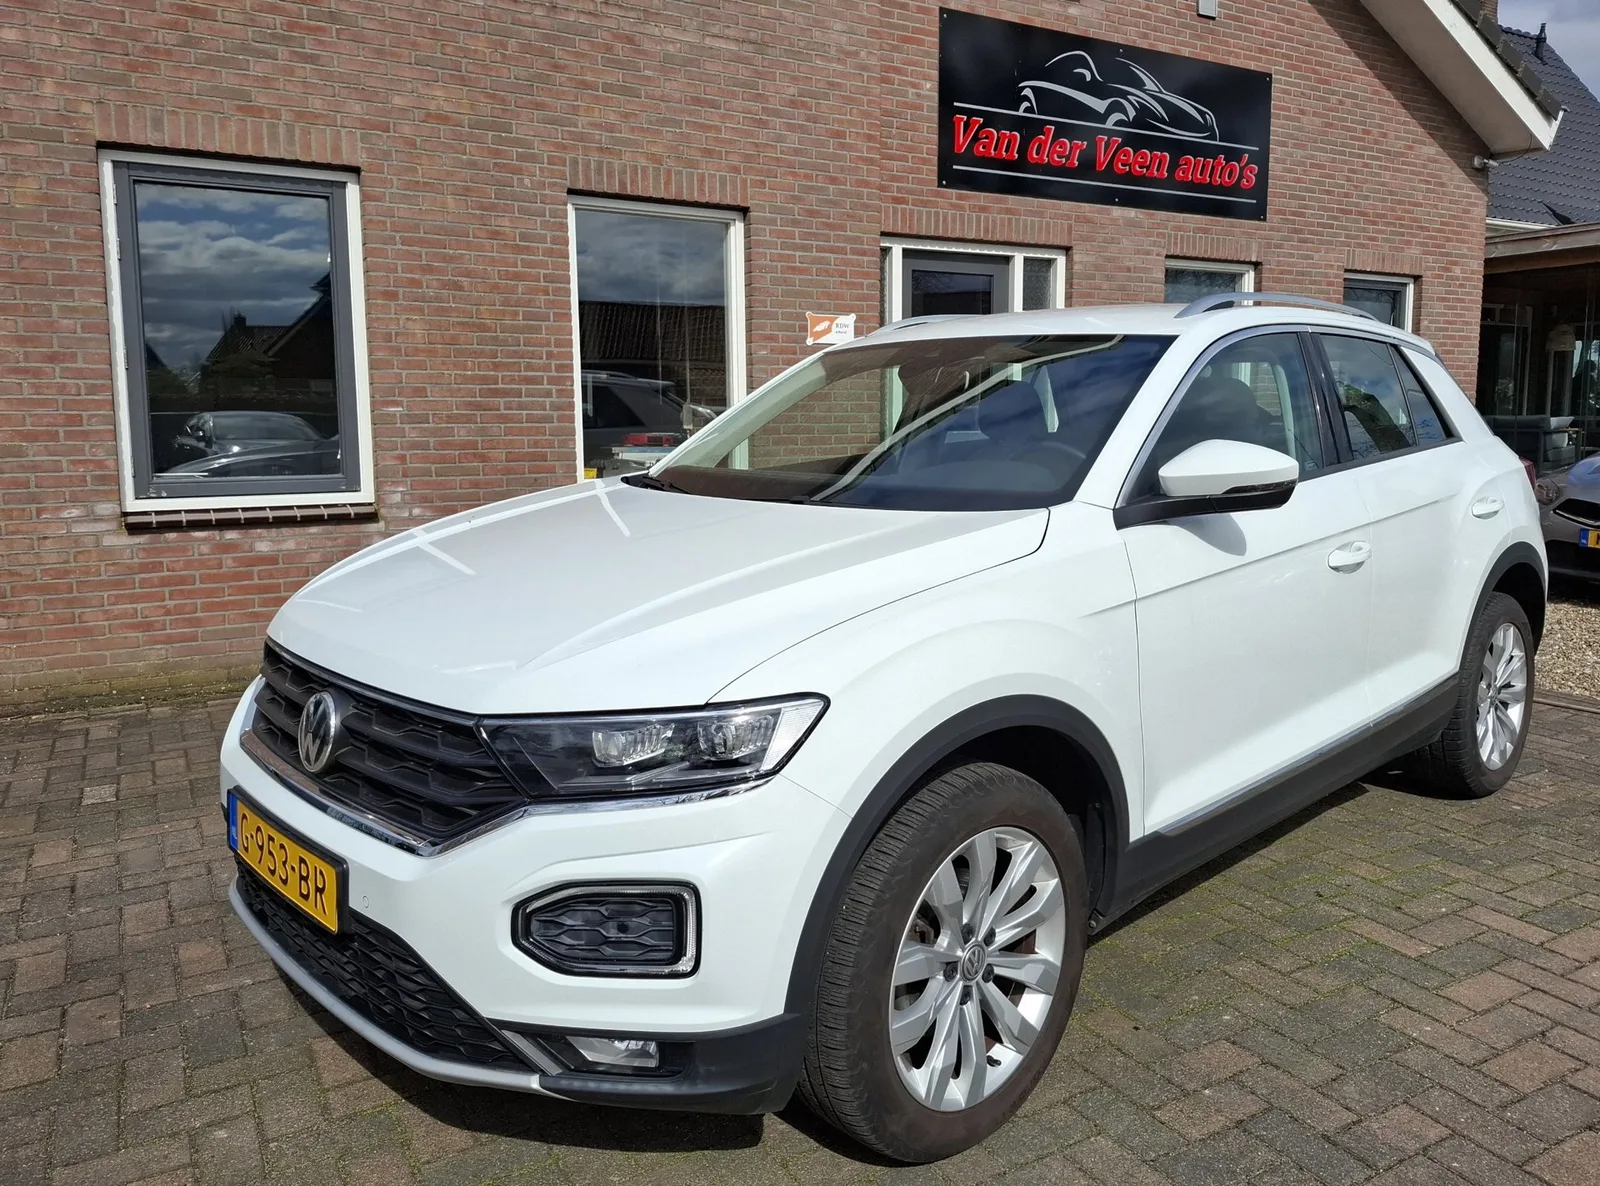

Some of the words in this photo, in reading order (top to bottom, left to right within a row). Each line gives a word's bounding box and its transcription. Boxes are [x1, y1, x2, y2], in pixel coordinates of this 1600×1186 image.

[952, 115, 1019, 161] Van
[1027, 126, 1087, 168] der
[1095, 135, 1170, 178] Veen
[1174, 153, 1259, 190] auto's
[240, 812, 328, 916] G-953-BR
